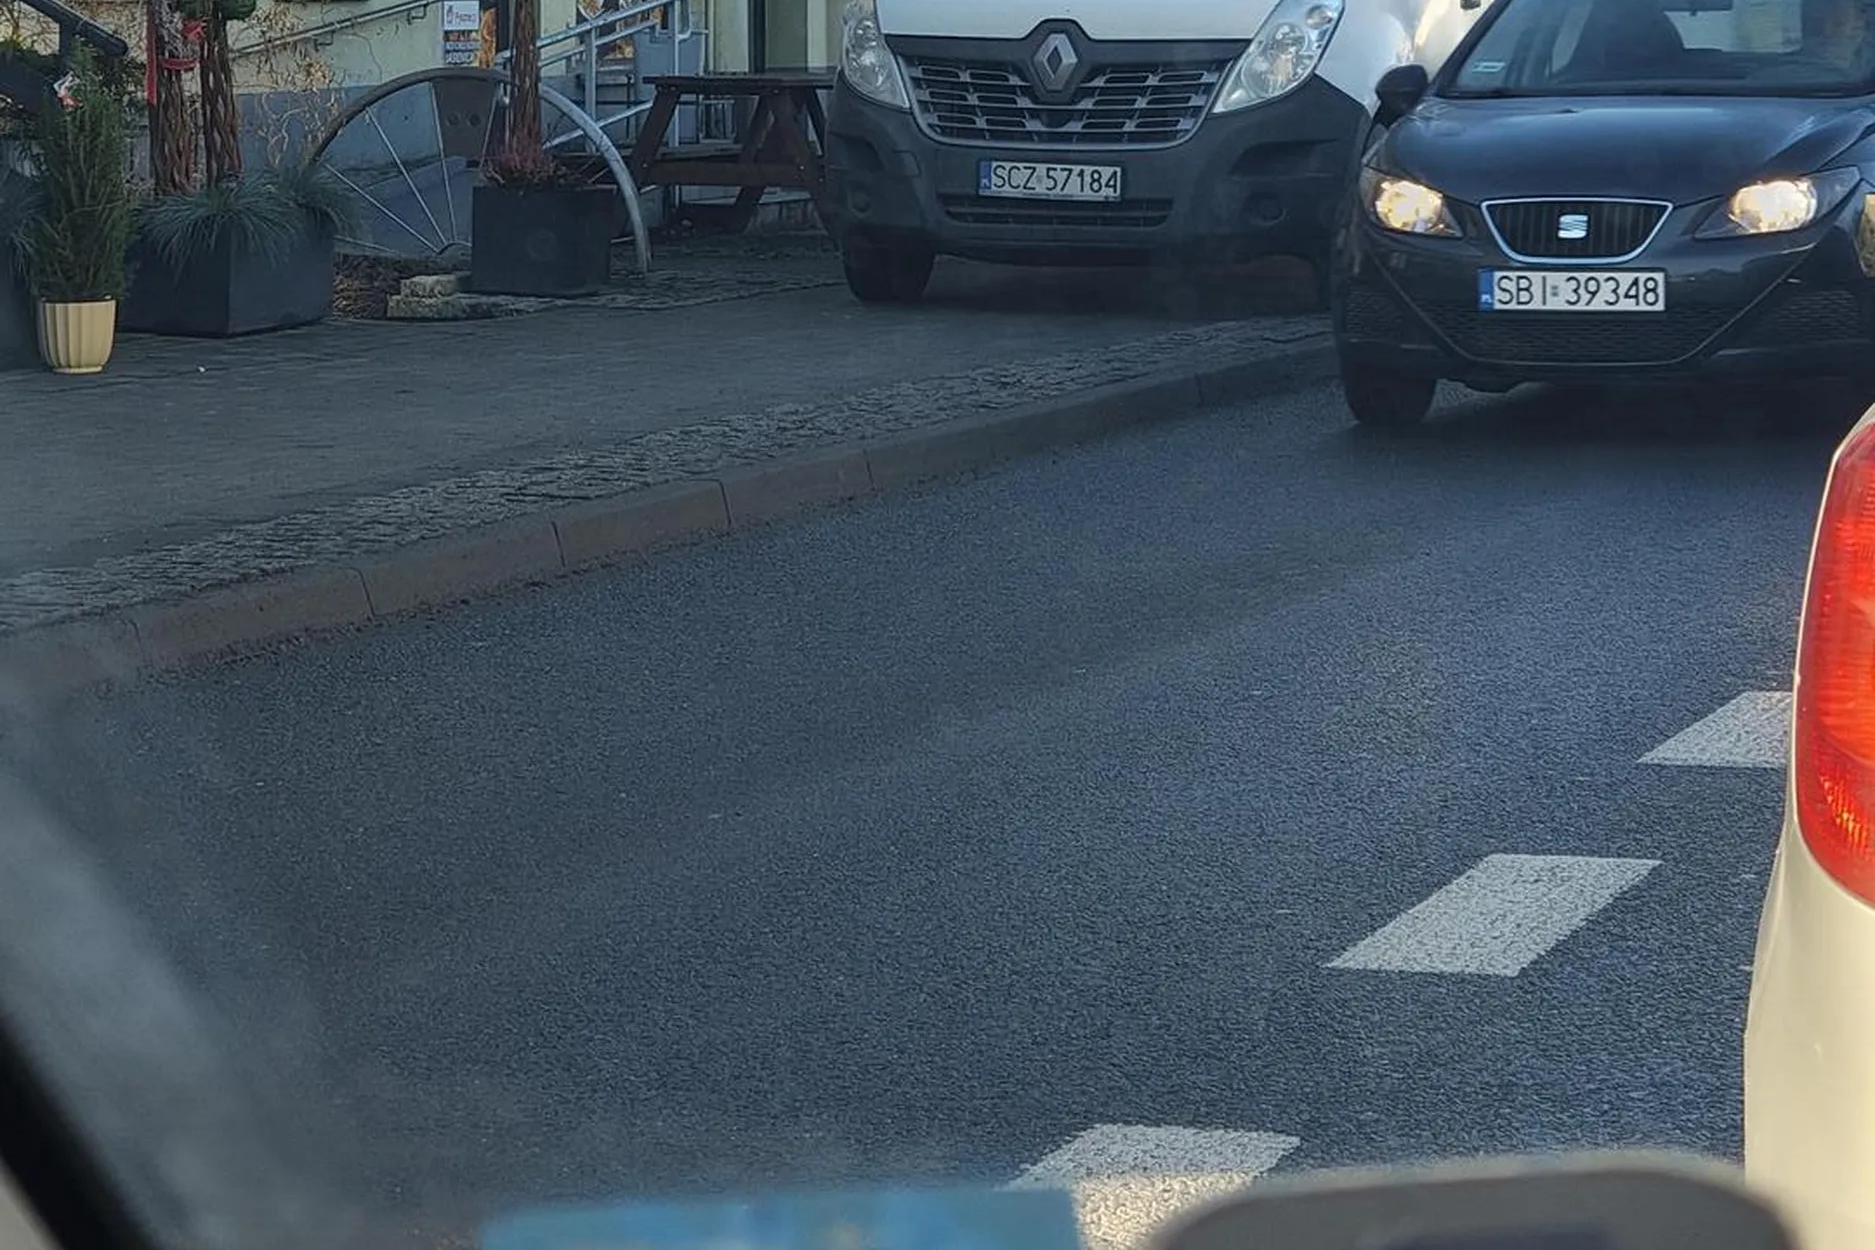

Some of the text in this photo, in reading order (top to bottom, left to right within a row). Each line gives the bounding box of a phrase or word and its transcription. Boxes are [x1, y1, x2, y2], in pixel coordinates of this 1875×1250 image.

[993, 165, 1118, 194] SCZ 57184
[1497, 275, 1547, 306] SBI
[1565, 276, 1660, 306] 39348
